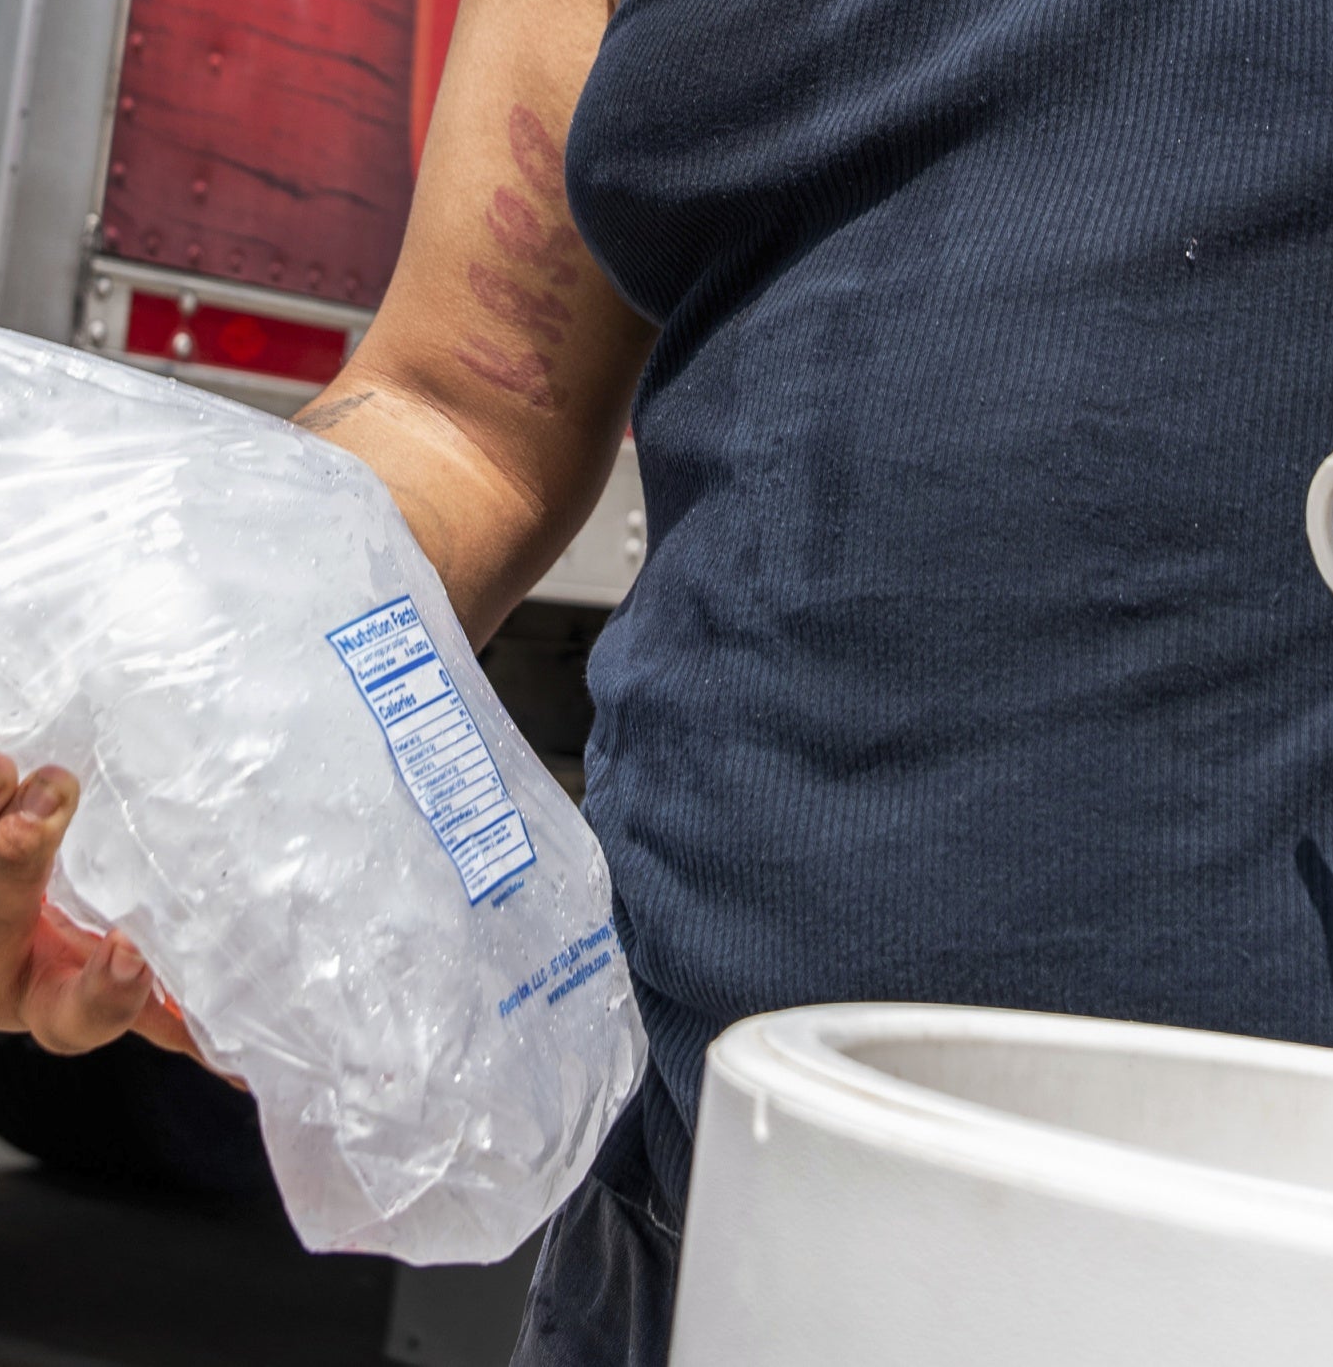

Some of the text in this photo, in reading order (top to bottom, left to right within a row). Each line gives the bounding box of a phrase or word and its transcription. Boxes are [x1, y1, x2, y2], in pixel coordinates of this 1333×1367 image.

[337, 619, 395, 654] Nutrition
[390, 606, 418, 627] Facts
[378, 669, 450, 720] Calories 0
[531, 966, 548, 991] LLC
